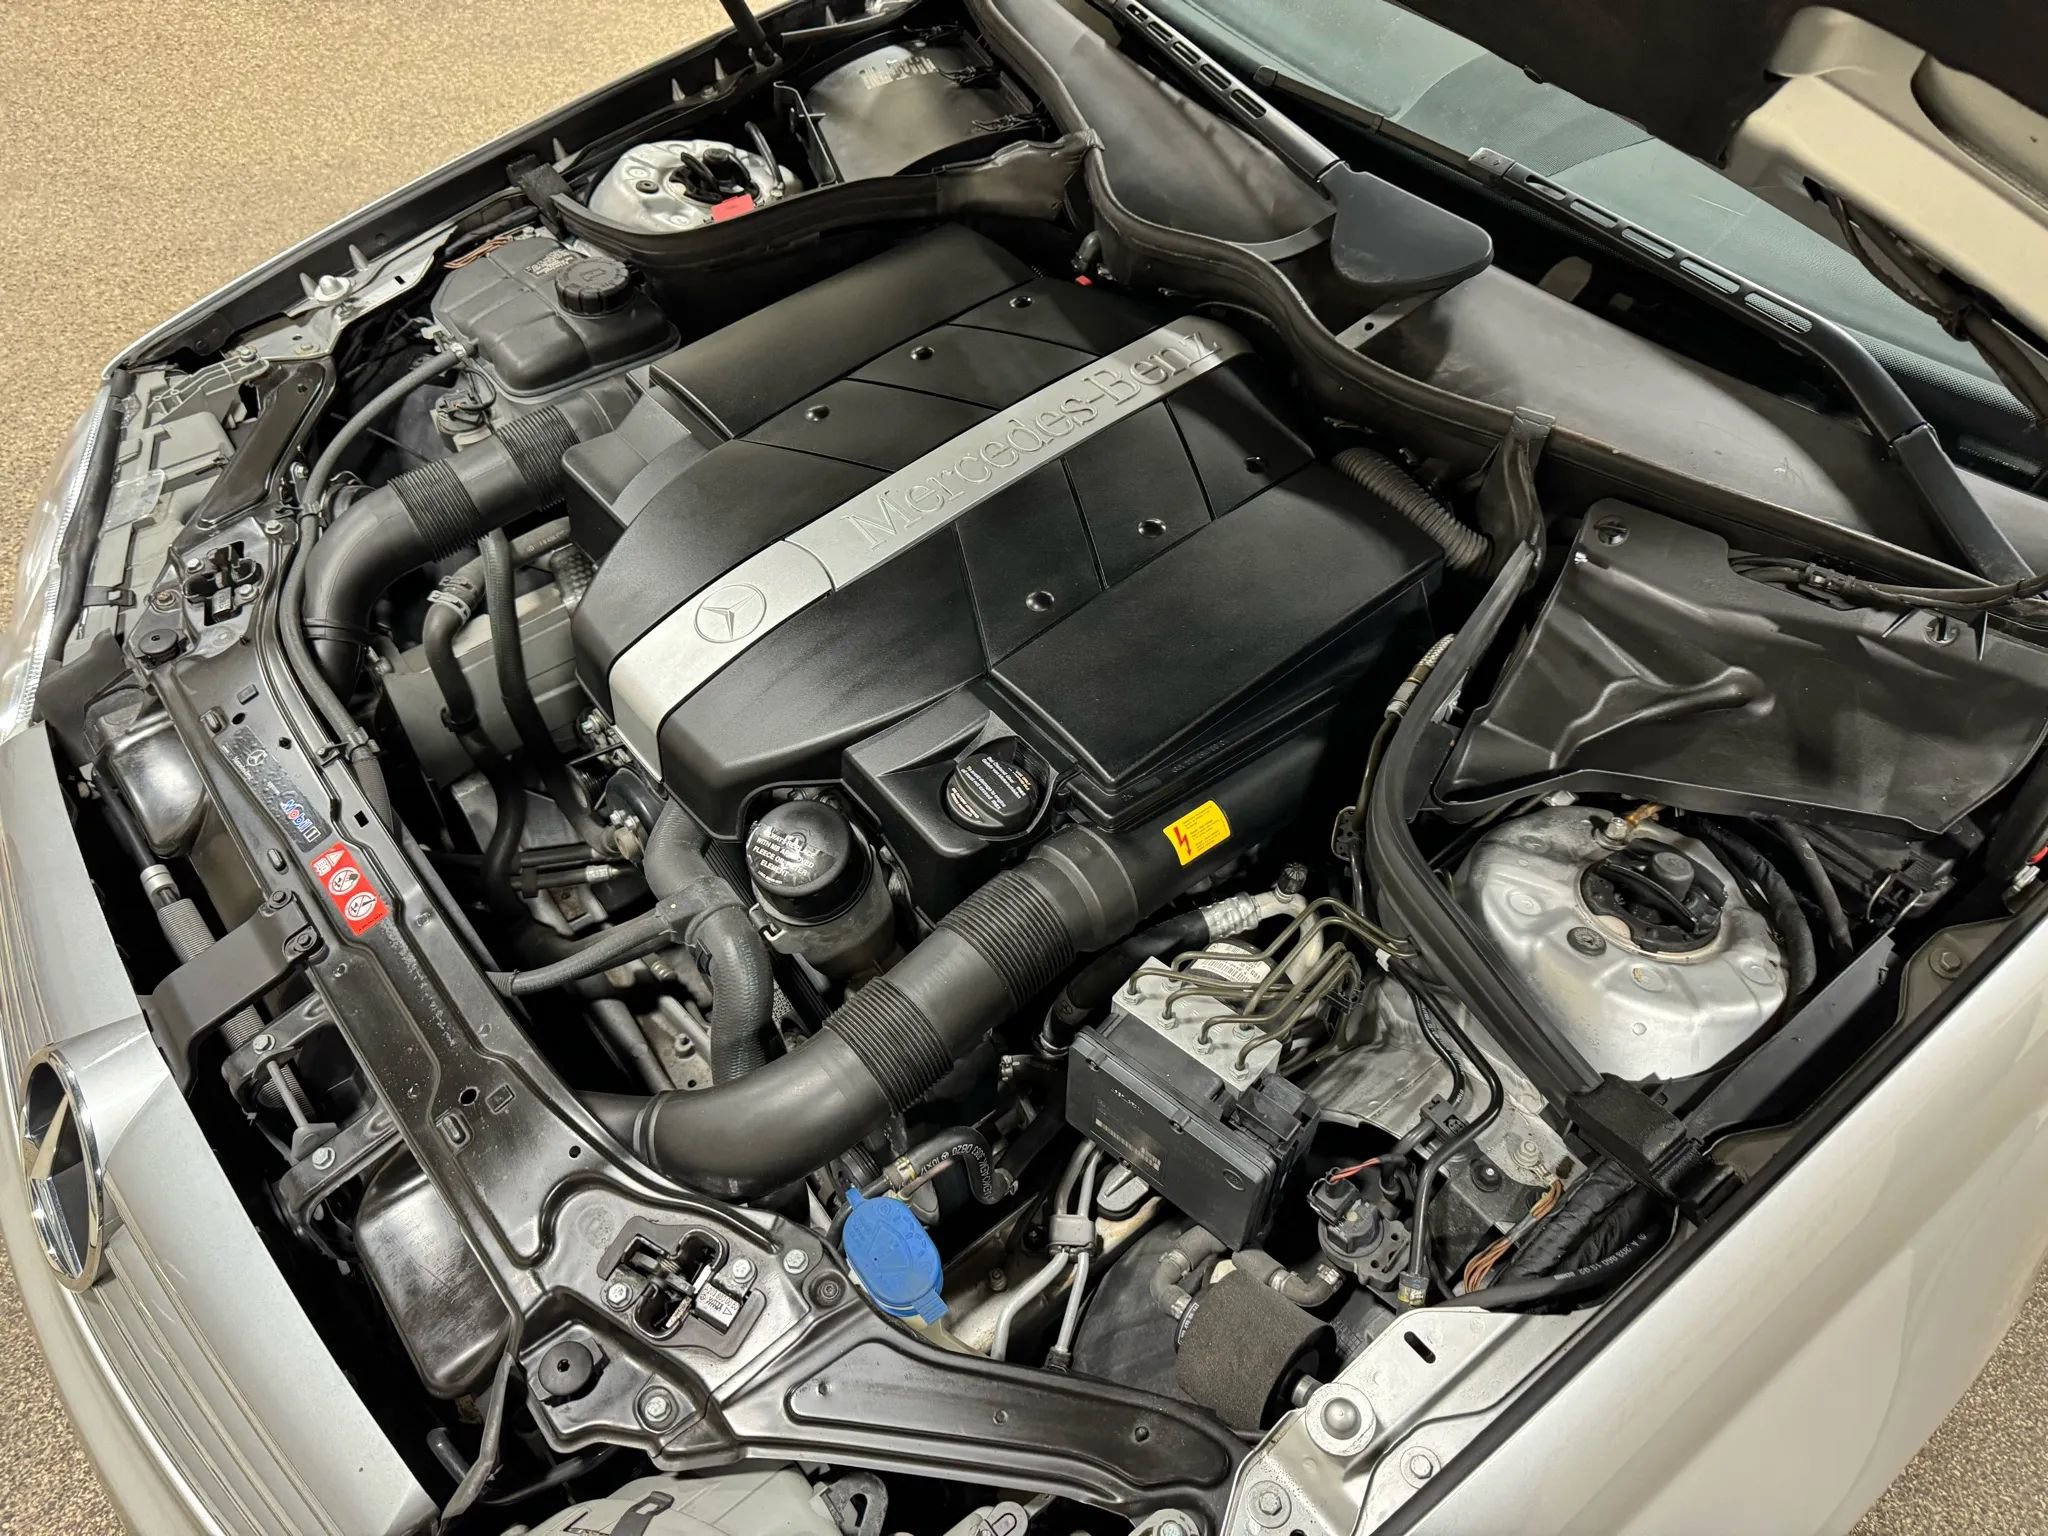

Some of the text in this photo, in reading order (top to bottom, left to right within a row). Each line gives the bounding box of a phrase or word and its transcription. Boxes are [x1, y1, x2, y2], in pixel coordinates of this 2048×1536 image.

[839, 331, 1222, 549] Mercedes-Benz
[280, 799, 313, 833] Mobil
[752, 845, 776, 861] FLEECE
[756, 837, 771, 848] WITH
[770, 842, 781, 852] MB
[760, 859, 790, 877] ELEMENT
